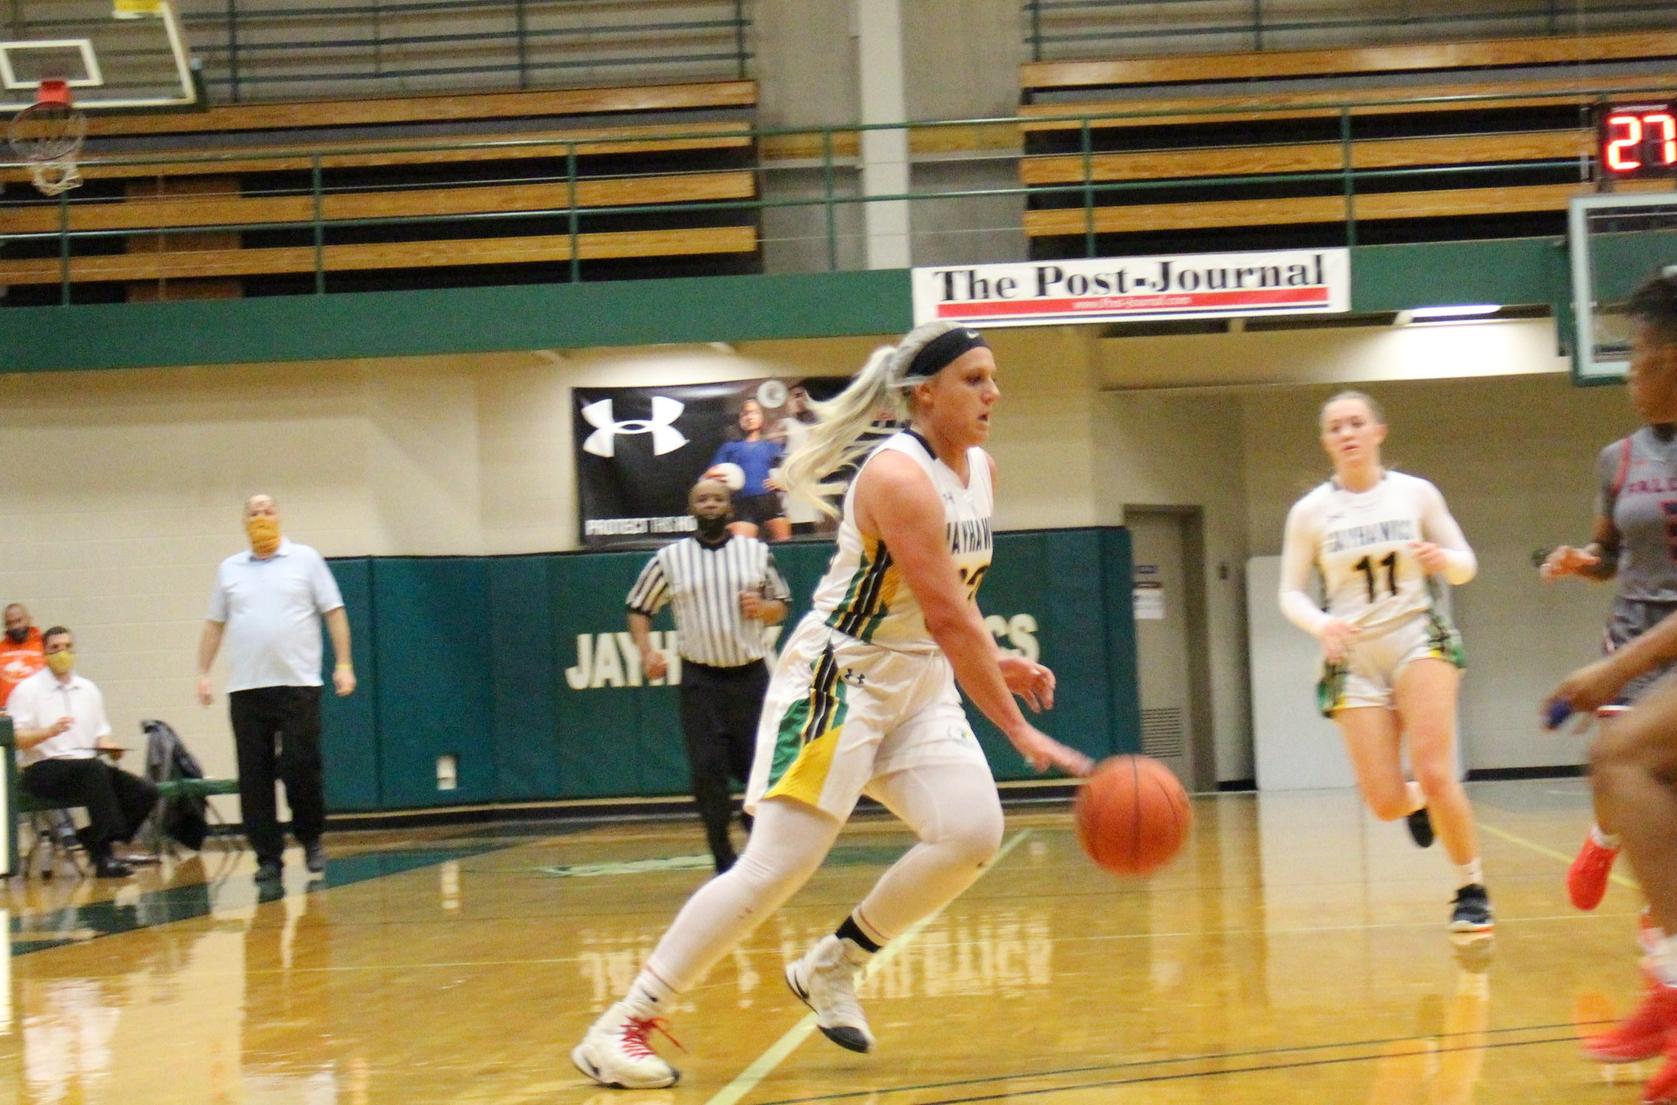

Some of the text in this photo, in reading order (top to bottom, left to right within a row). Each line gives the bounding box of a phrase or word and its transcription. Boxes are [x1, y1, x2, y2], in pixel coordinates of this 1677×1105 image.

[1607, 115, 1677, 170] 27
[934, 255, 1324, 301] The Post-Journal
[1354, 551, 1397, 603] 11
